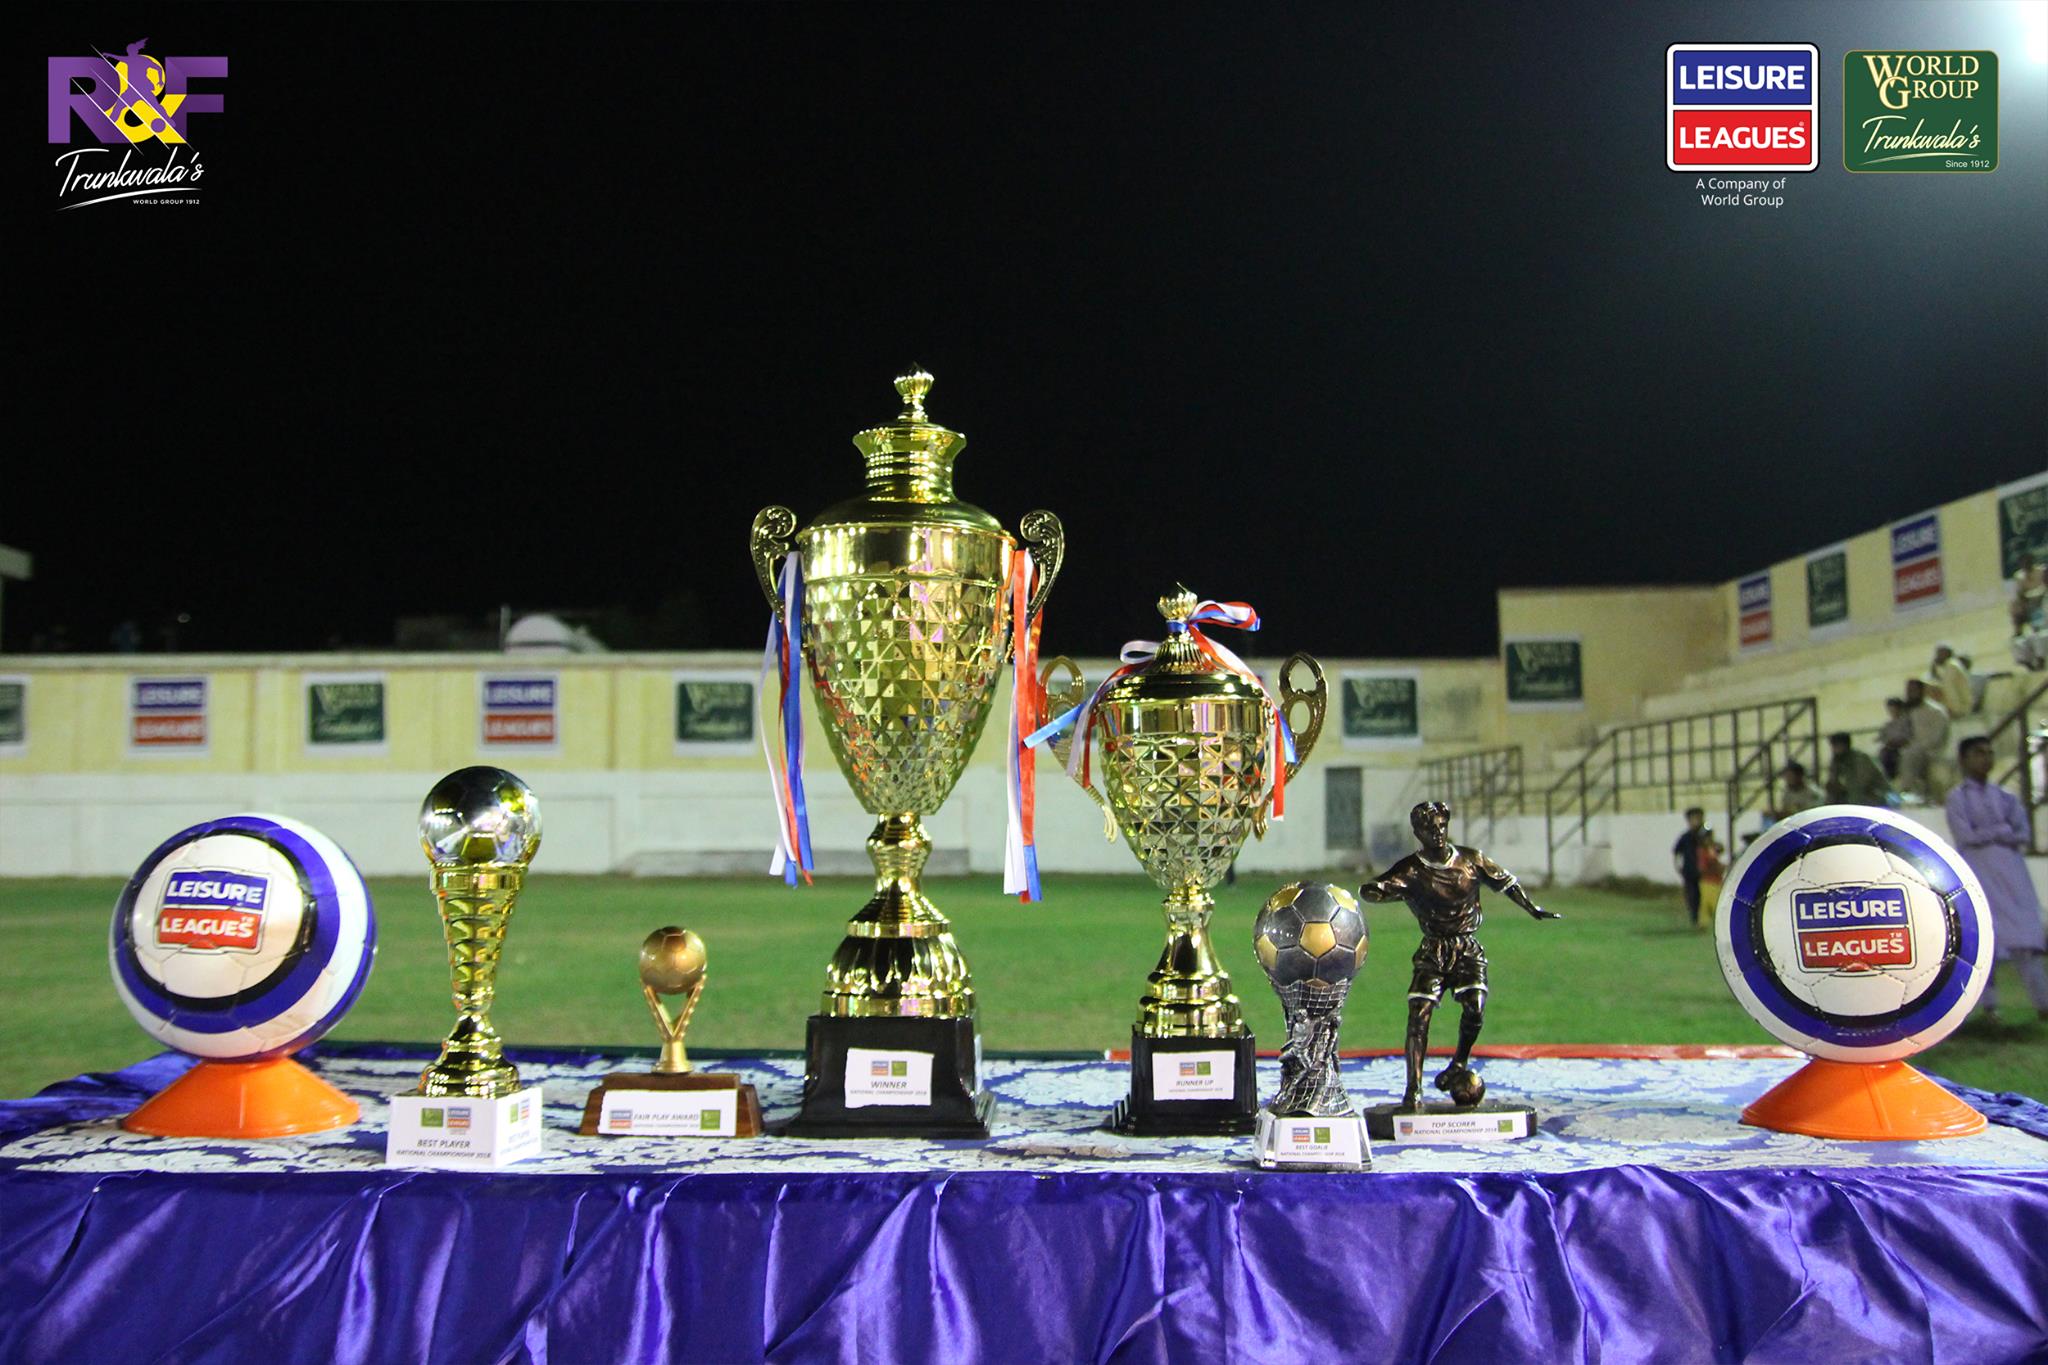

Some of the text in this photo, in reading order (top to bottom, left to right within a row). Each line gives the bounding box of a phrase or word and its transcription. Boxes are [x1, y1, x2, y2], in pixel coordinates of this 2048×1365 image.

[167, 880, 263, 904] LEISURE
[1799, 899, 1903, 920] LEISURE
[160, 917, 255, 938] LEAGUES
[1803, 936, 1905, 957] LEAGUES
[417, 1139, 471, 1148] BEST PLAYER
